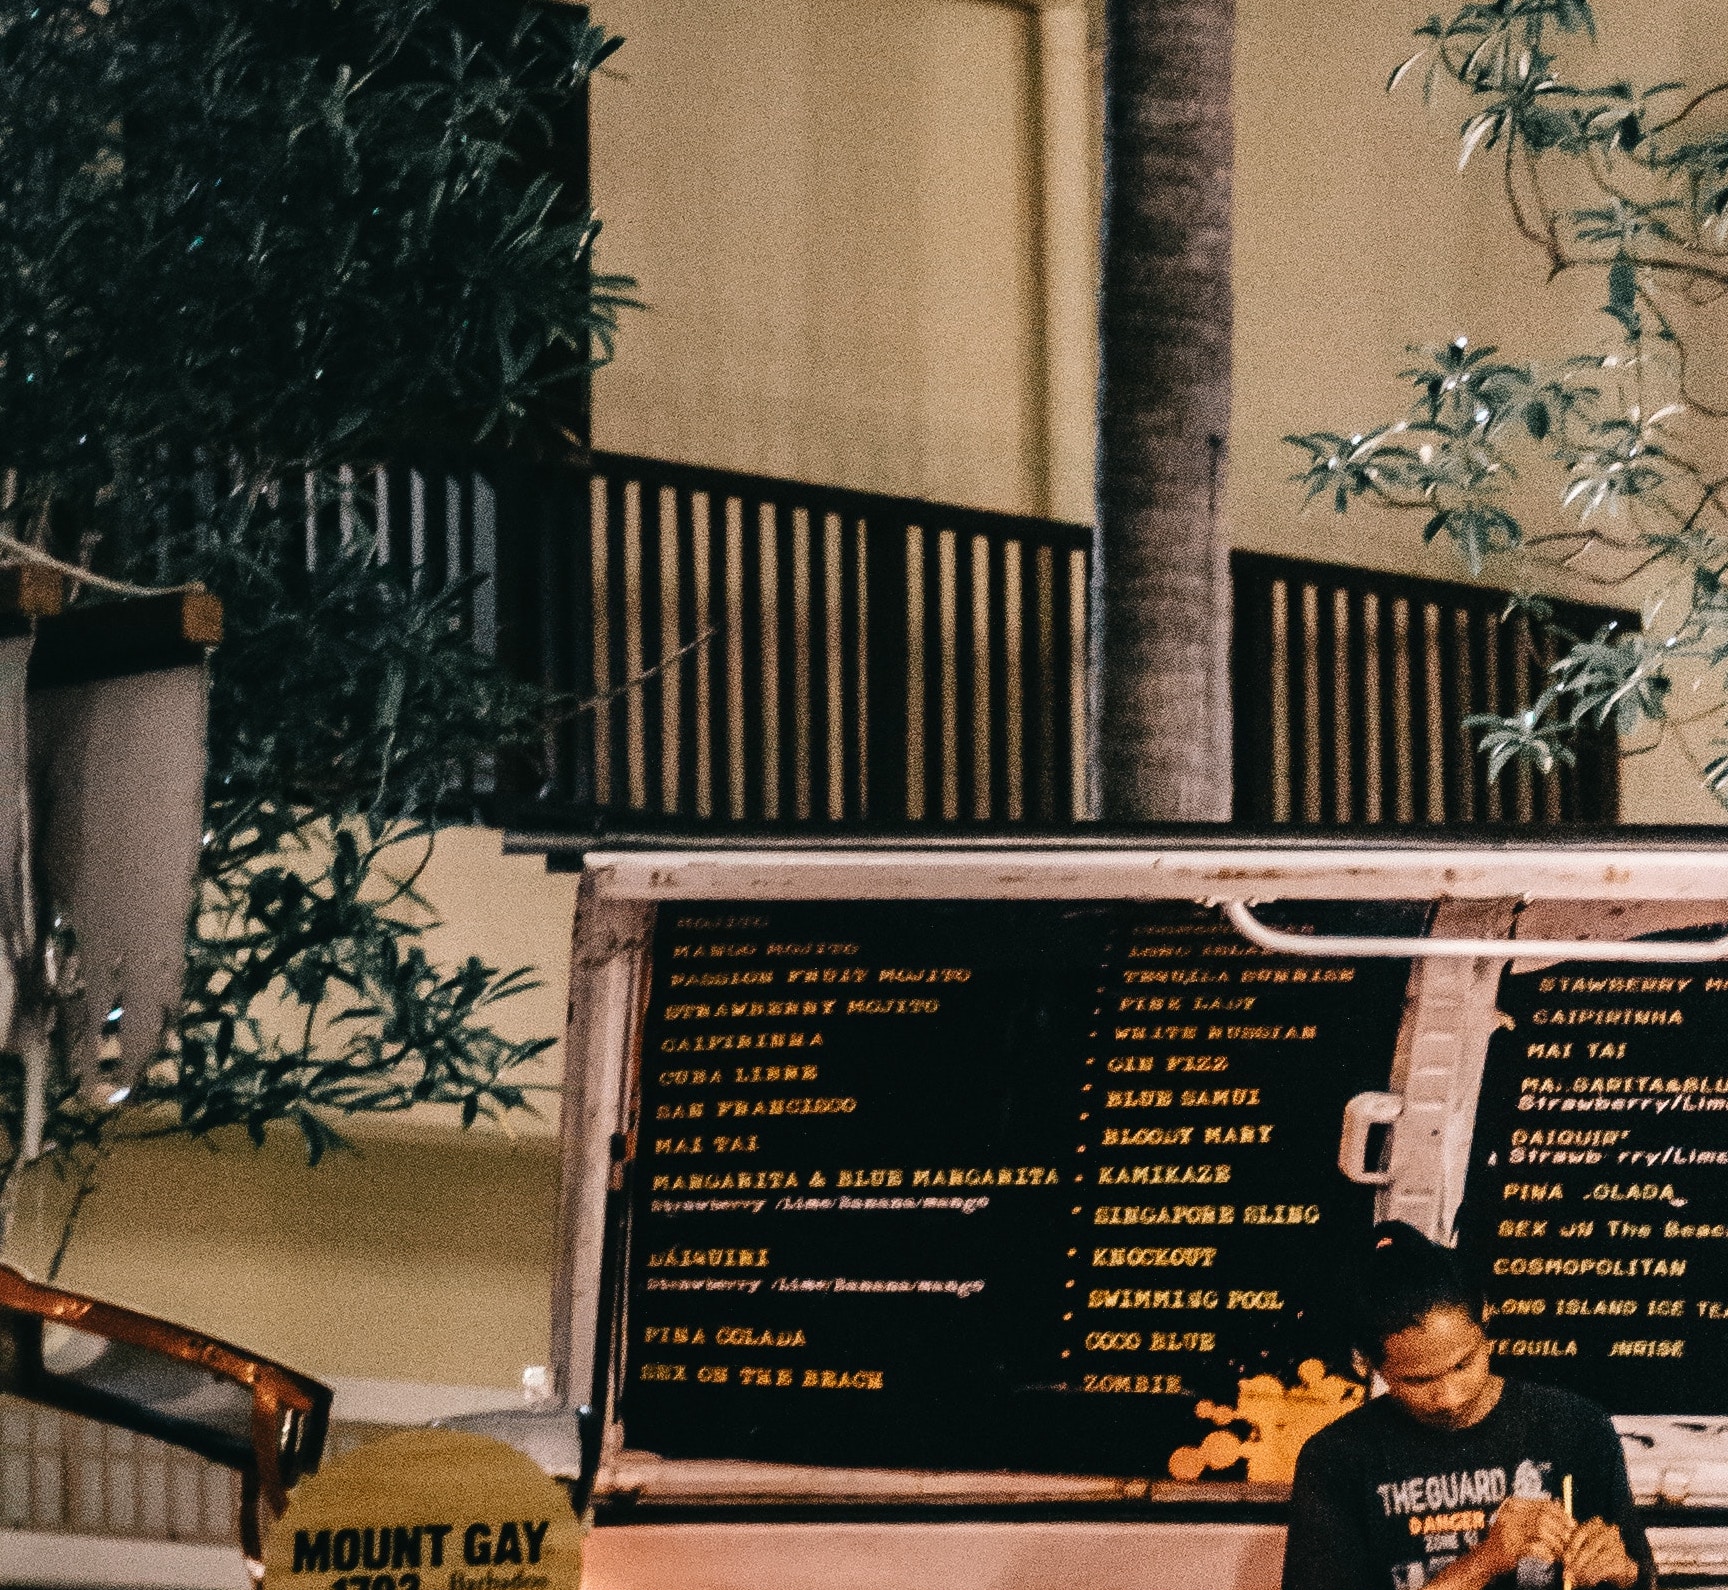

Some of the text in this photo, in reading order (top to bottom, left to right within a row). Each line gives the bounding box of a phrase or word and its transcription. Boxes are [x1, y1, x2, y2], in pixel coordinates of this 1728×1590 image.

[671, 969, 971, 986] PASSION FRUIT MOJITO
[1124, 970, 1228, 985] TEQUILA
[665, 999, 939, 1020] STRAWBERRY MOJITO
[1533, 1009, 1683, 1024] CAIPIRINHA
[1115, 1026, 1316, 1040] WHITE RUSSIAN
[1527, 1043, 1626, 1059] MAI TAI
[1108, 1056, 1228, 1072] GIN FIZZ
[659, 1065, 817, 1085] CUBA LIBRE
[1106, 1088, 1259, 1107] BLUE SAMUI
[657, 1098, 856, 1119] SAN FRANCISCO
[655, 1135, 757, 1153] MAI TAI
[1102, 1125, 1272, 1145] BLOODY MARY
[653, 1167, 1057, 1190] MARGARITA & BLUE MARGARITA
[1099, 1165, 1230, 1184] KAMIKAZE
[1504, 1184, 1674, 1200] PINA OLADA
[1094, 1205, 1319, 1224] SINGAPORE SLING
[1498, 1220, 1547, 1237] SEX
[1093, 1247, 1216, 1266] KNOCKOUT
[1494, 1258, 1686, 1276] COSMOPOLITAN
[1088, 1289, 1283, 1310] SWIMMING POOL
[1556, 1299, 1637, 1315] ISLAND
[1648, 1300, 1684, 1316] ICE
[716, 1328, 805, 1347] COLADA
[1085, 1332, 1215, 1351] COCO BLUE
[1608, 1340, 1685, 1357] NRISE
[641, 1364, 883, 1389] SEX ON THE BEACH
[1084, 1375, 1181, 1394] ZOMBIE
[293, 1519, 550, 1573] MOUNT GAY
